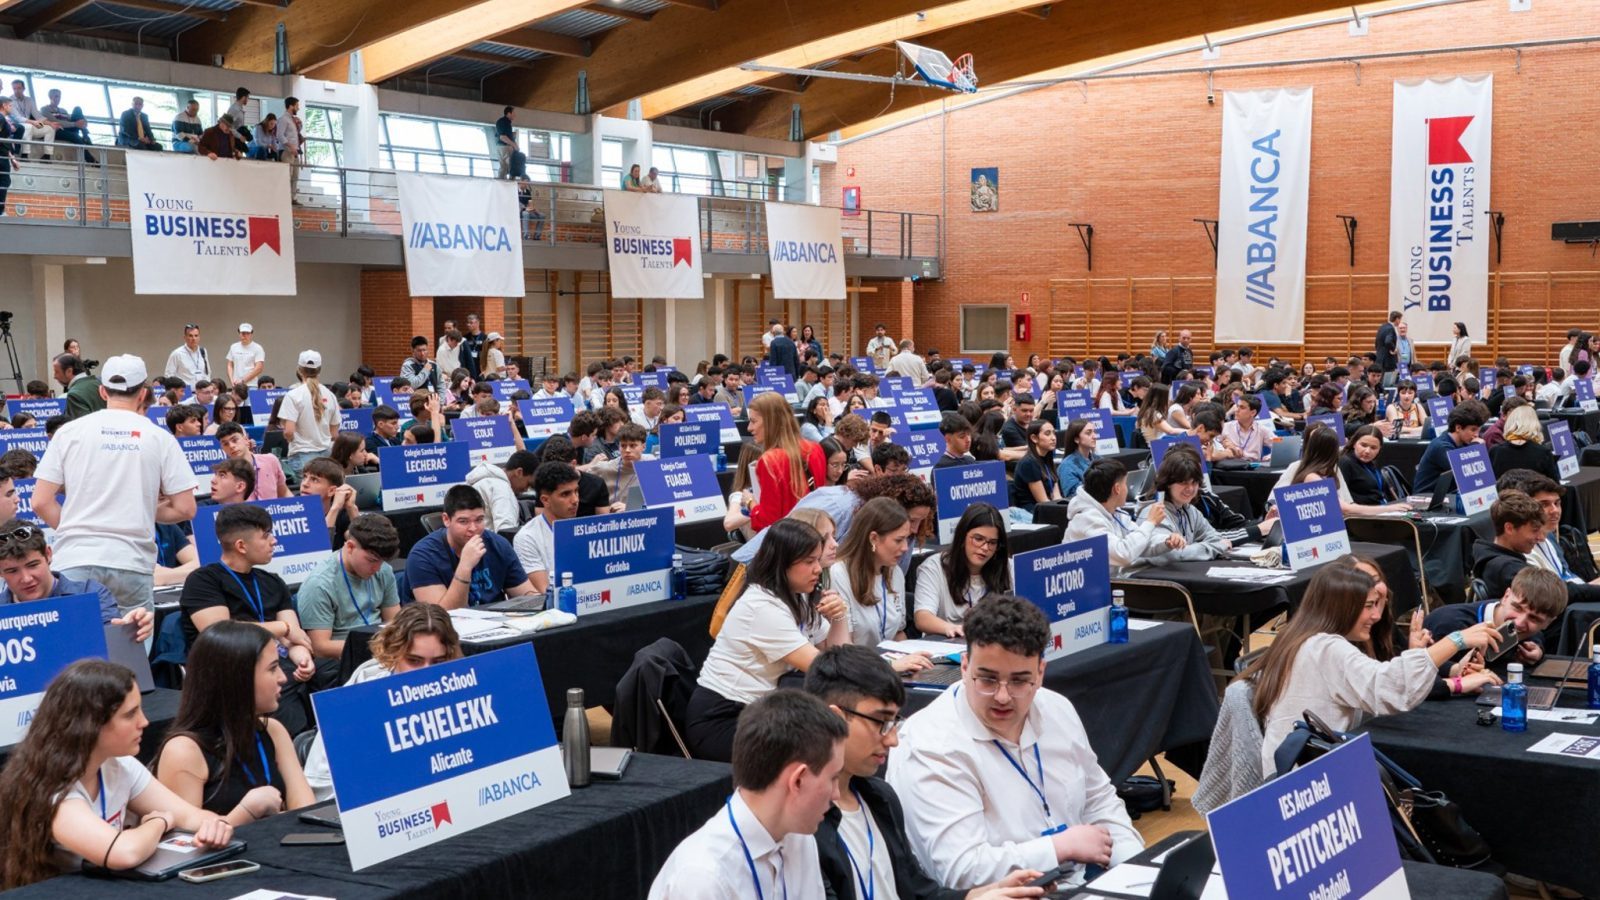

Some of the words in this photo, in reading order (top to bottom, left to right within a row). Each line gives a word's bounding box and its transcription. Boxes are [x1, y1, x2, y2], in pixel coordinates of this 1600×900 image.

[145, 214, 248, 239] BUSINESS
[613, 237, 673, 256] BUSINESS
[1428, 167, 1455, 312] BUSINESS
[183, 449, 227, 462] EENFRIDAY
[405, 457, 448, 473] LECHERAS
[664, 472, 693, 488] FUAGRI
[272, 517, 310, 537] MENTE
[574, 525, 584, 537] IES
[584, 523, 597, 535] Luis
[597, 520, 619, 533] Carrillo
[619, 519, 628, 530] de
[627, 516, 658, 530] Sotomayor
[588, 533, 646, 560] KALILINUX
[605, 560, 630, 575] Córdoba
[1033, 559, 1042, 571] IES
[1042, 556, 1057, 571] Duque
[1057, 554, 1064, 567] de
[1045, 567, 1085, 598] LACTORO
[576, 593, 601, 604] USINESS
[1057, 599, 1076, 617] Segovia
[387, 688, 404, 707] La
[403, 679, 443, 705] Devesa
[441, 667, 478, 694] School
[384, 694, 499, 753] LECHELEKK
[430, 746, 474, 775] Alicante
[1278, 792, 1297, 821] IES
[1293, 787, 1316, 814] Arca
[1310, 772, 1332, 804] Real
[377, 808, 433, 839] BUSINESS
[1266, 801, 1363, 891] PETITCREAM
[1309, 868, 1352, 900] lladolid
